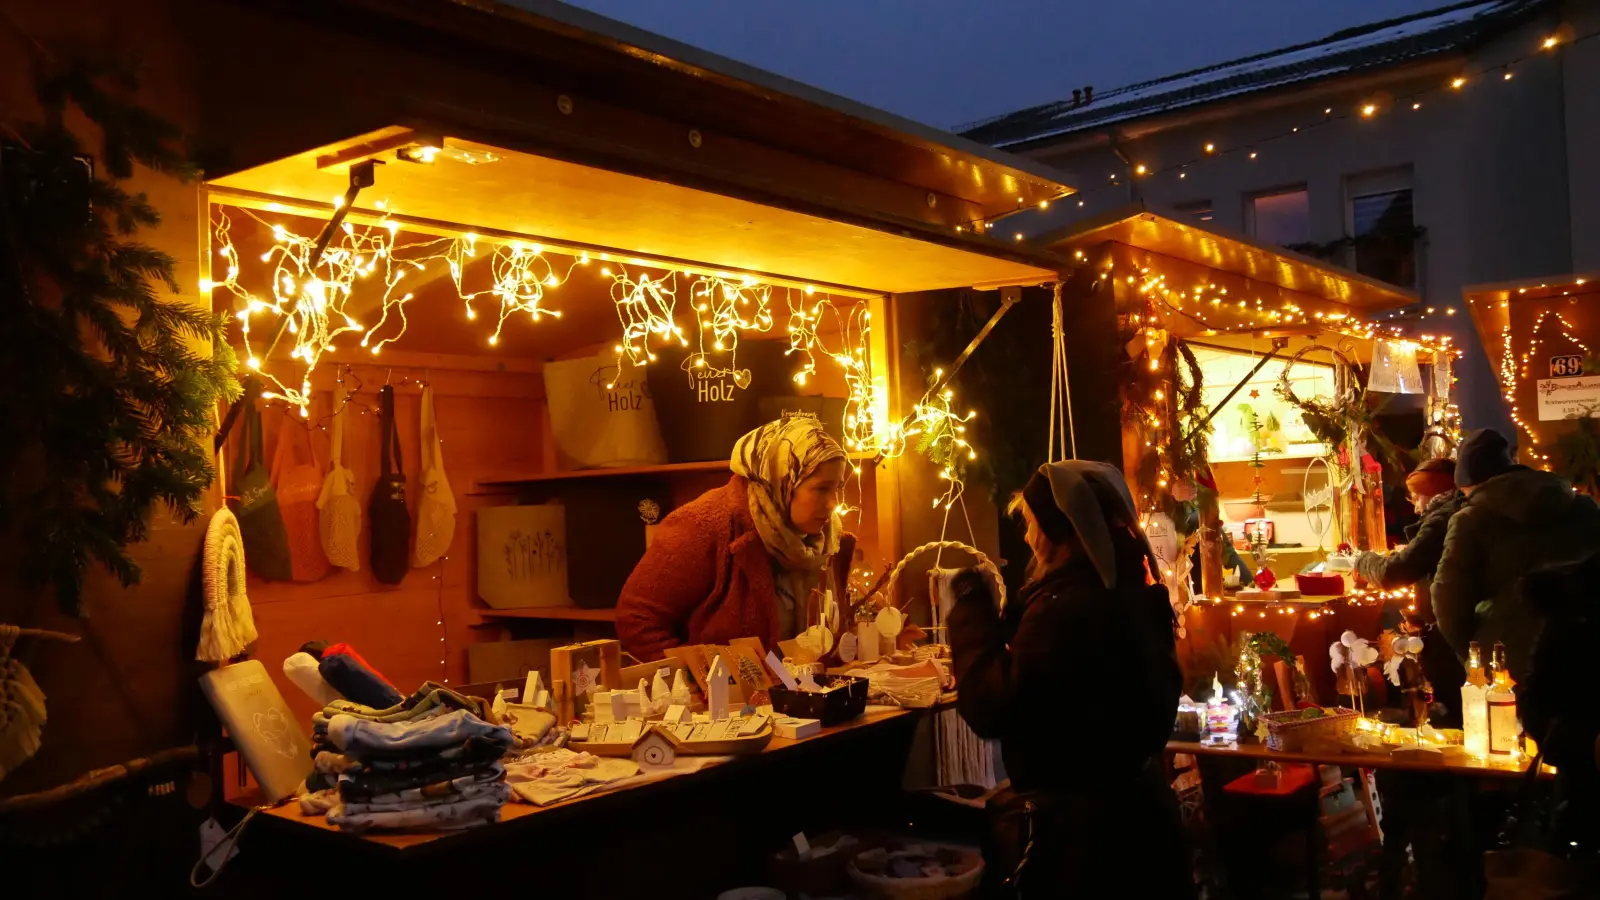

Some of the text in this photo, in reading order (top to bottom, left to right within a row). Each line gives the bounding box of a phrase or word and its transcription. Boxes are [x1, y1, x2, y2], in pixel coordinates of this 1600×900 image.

[680, 351, 731, 390] Feuer
[1555, 358, 1579, 375] 69
[588, 365, 638, 401] Fuer
[698, 380, 735, 403] Holz
[608, 390, 642, 412] Holz
